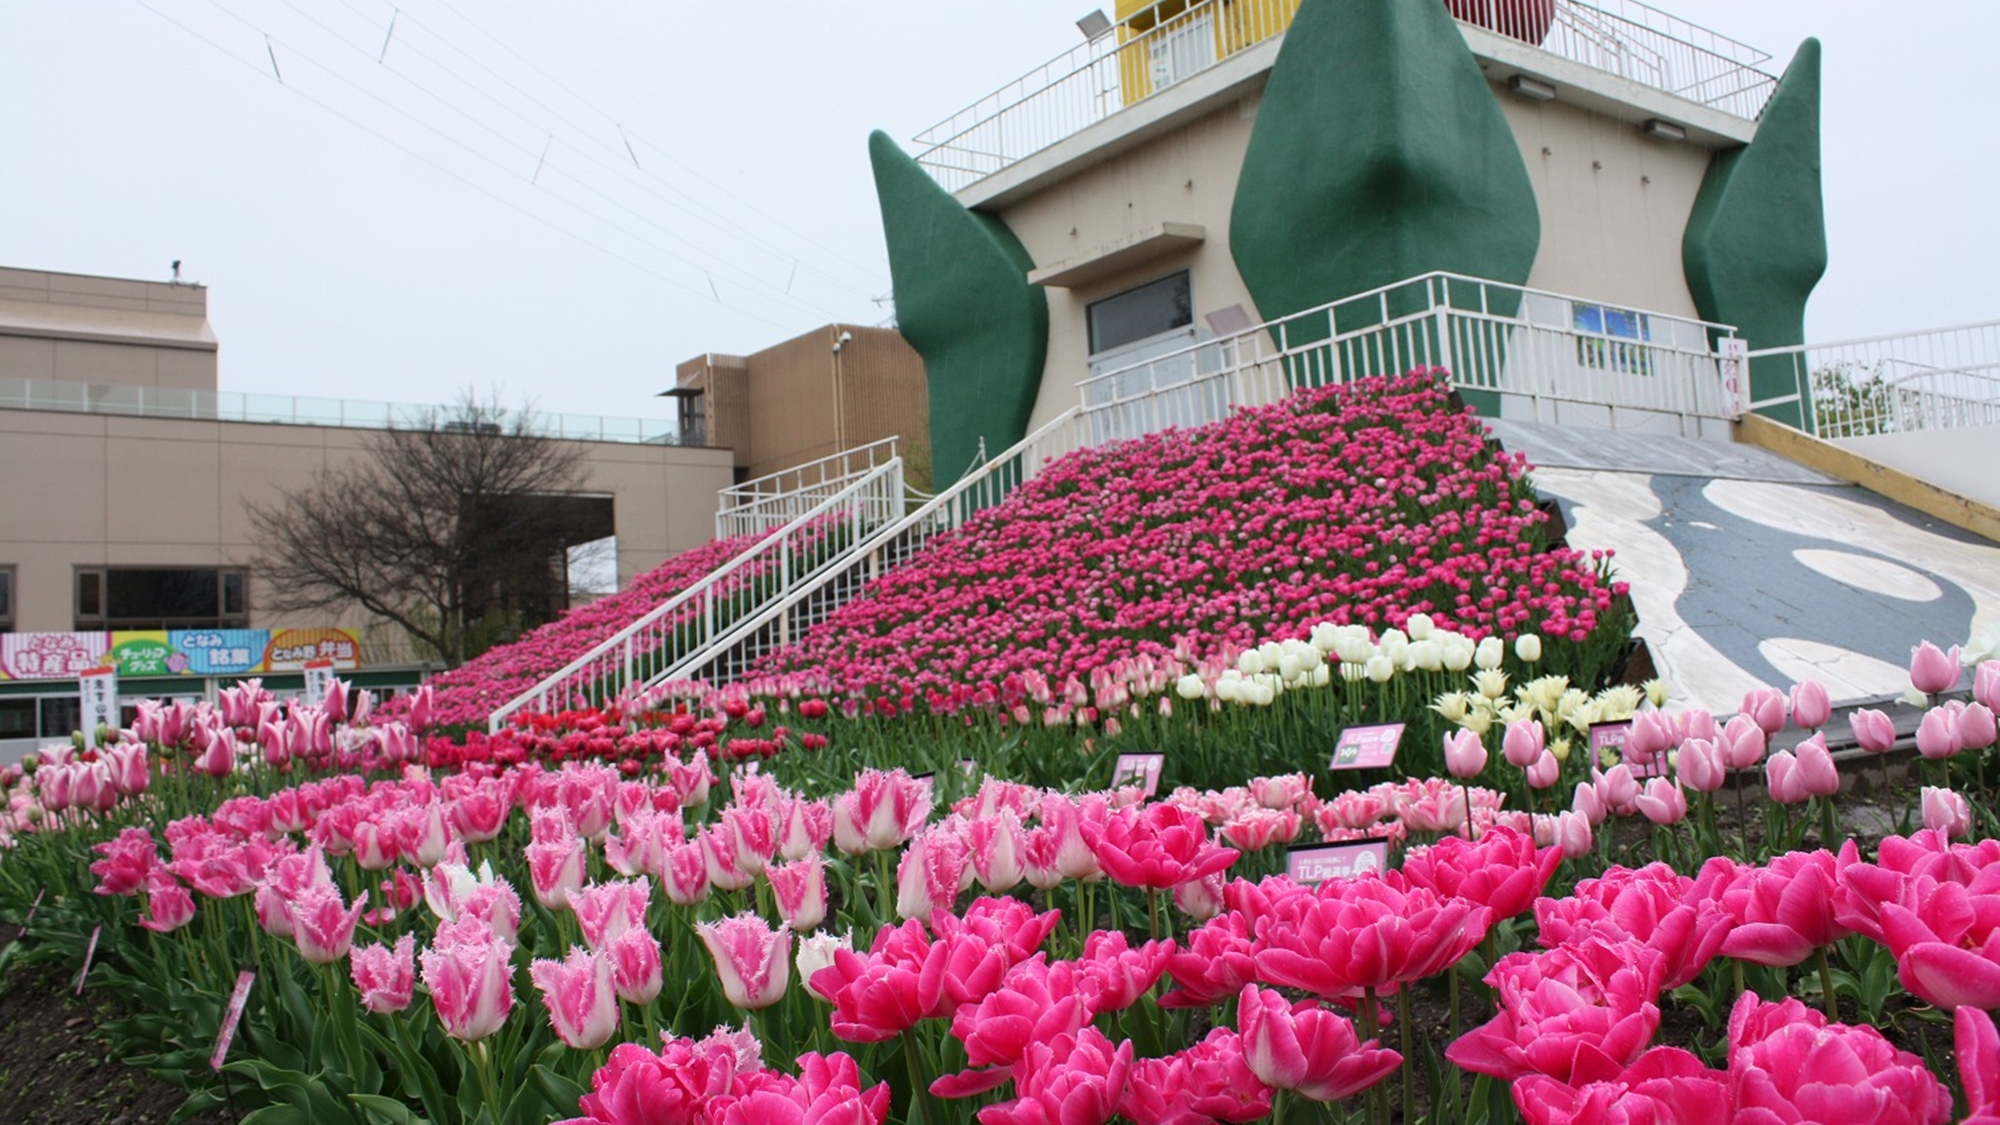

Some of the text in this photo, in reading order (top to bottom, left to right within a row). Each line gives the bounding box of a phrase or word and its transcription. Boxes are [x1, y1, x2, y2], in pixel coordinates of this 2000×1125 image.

[29, 635, 76, 650] となみ
[183, 634, 223, 648] となみ
[120, 647, 166, 660] チューリップ
[209, 648, 250, 665] 銘菓
[17, 650, 90, 674] 特産品
[130, 661, 158, 672] グッズ
